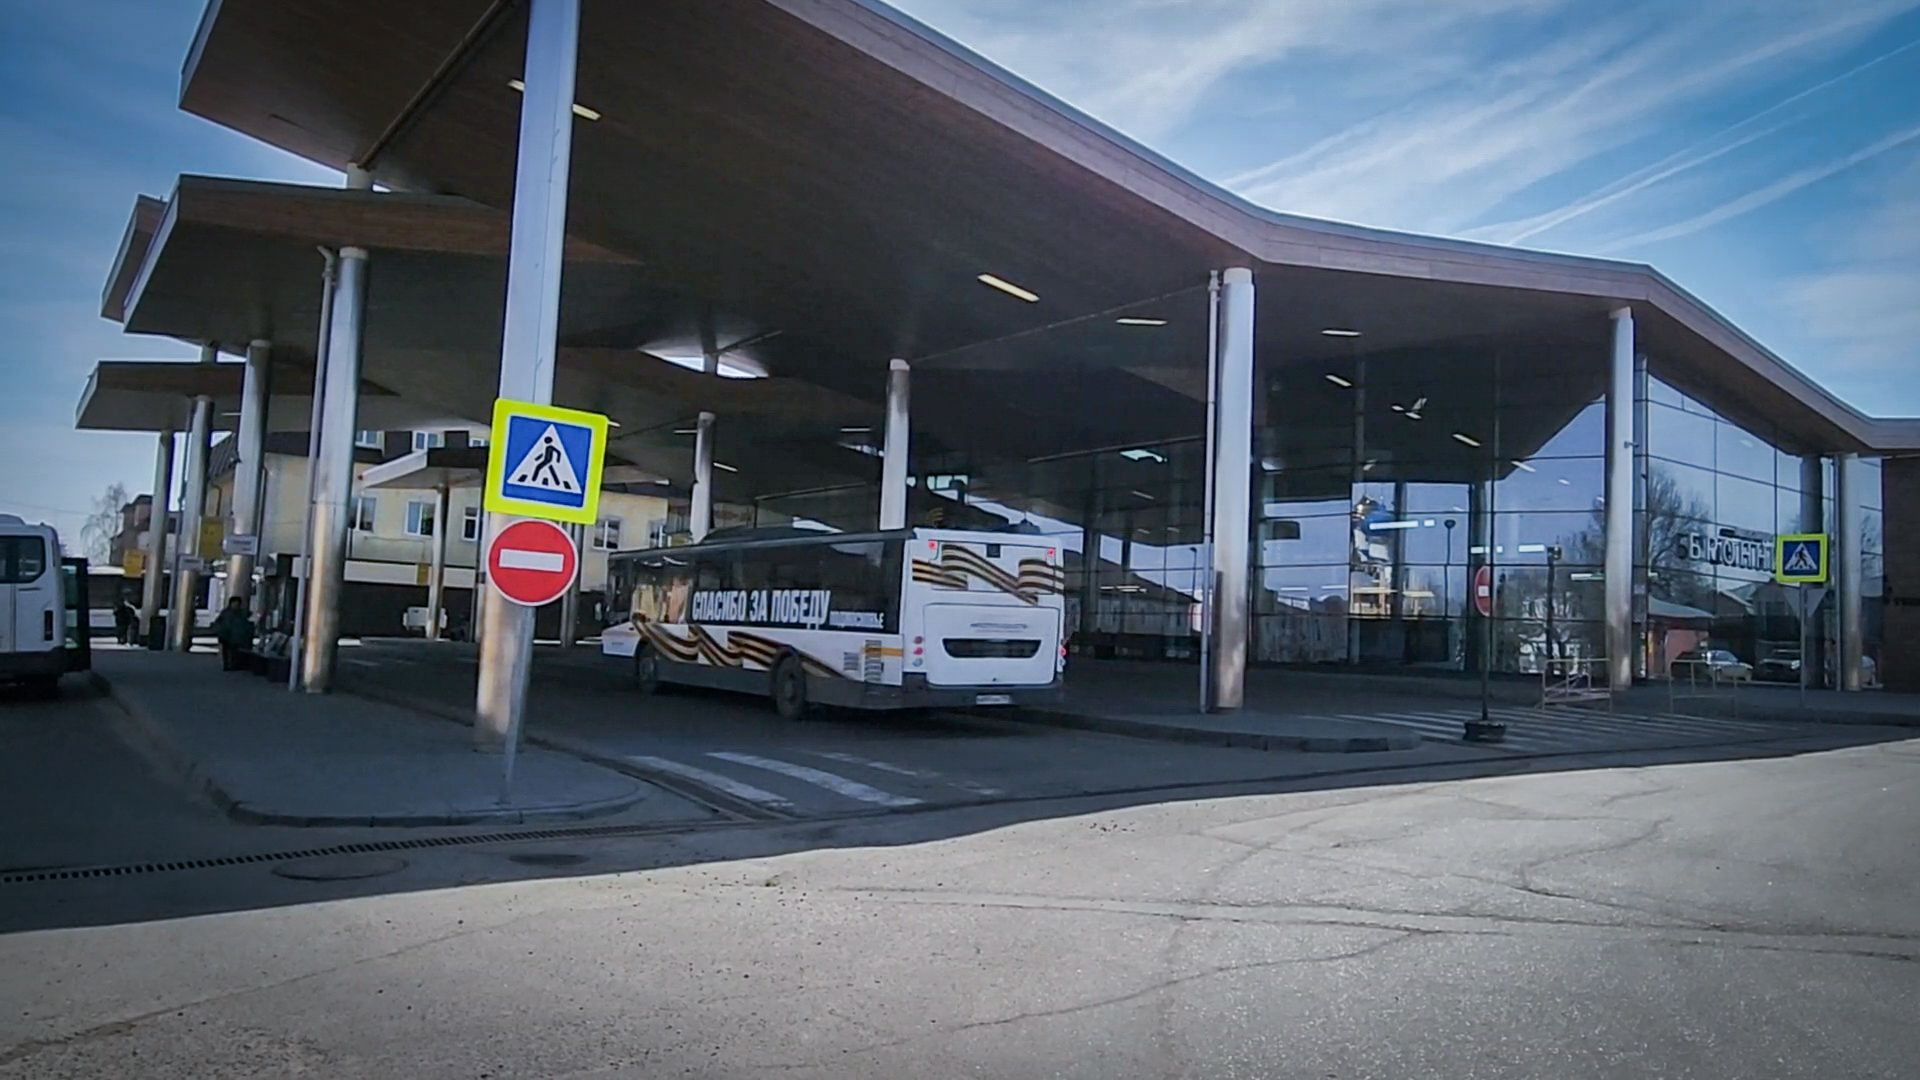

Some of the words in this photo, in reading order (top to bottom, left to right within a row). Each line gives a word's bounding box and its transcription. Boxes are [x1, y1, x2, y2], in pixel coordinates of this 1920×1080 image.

[691, 590, 748, 622] СПАСИБО
[749, 590, 768, 622] ЗА
[770, 590, 831, 631] ПОБЕДУ
